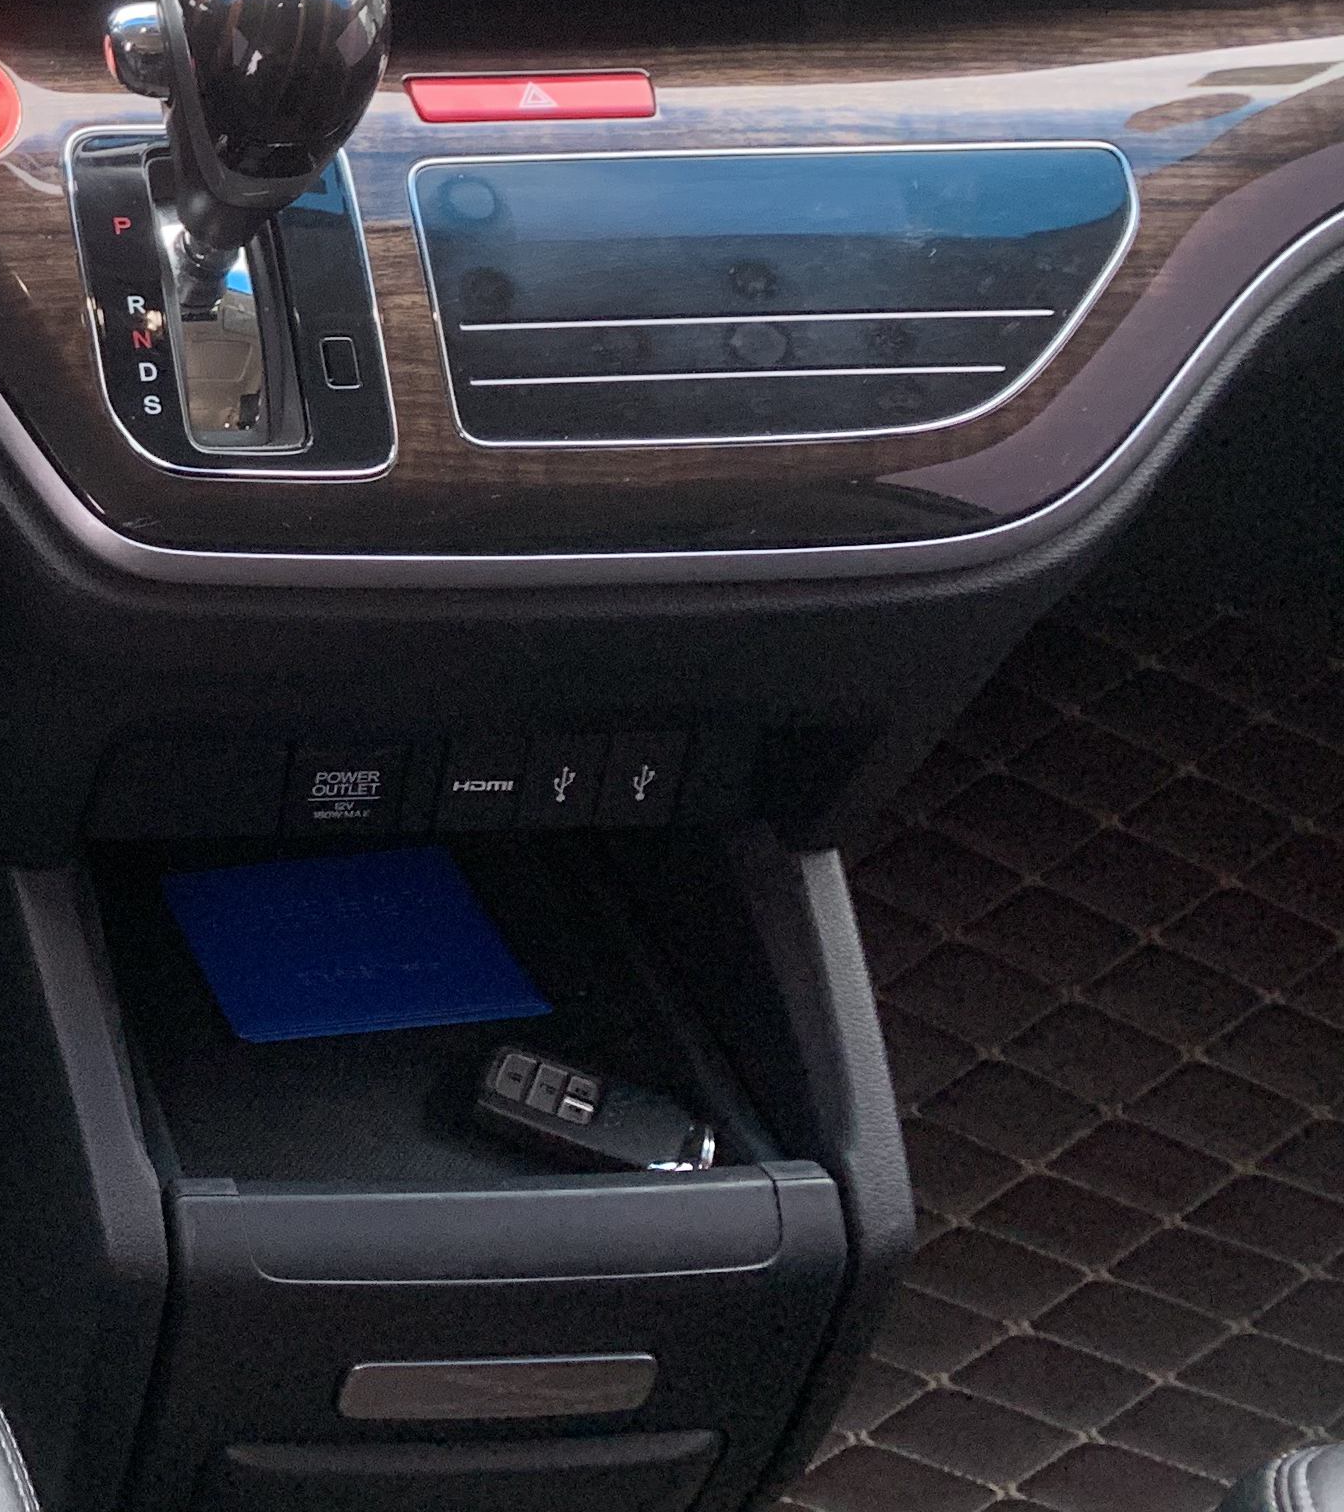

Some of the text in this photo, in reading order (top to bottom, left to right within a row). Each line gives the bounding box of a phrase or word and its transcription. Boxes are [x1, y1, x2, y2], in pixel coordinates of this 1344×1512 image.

[112, 216, 132, 235] P
[126, 295, 147, 315] R
[132, 329, 153, 350] N
[138, 361, 158, 382] D
[143, 395, 163, 416] S
[315, 770, 381, 784] POWER
[452, 780, 515, 792] HDMI
[312, 782, 382, 796] OUTLET
